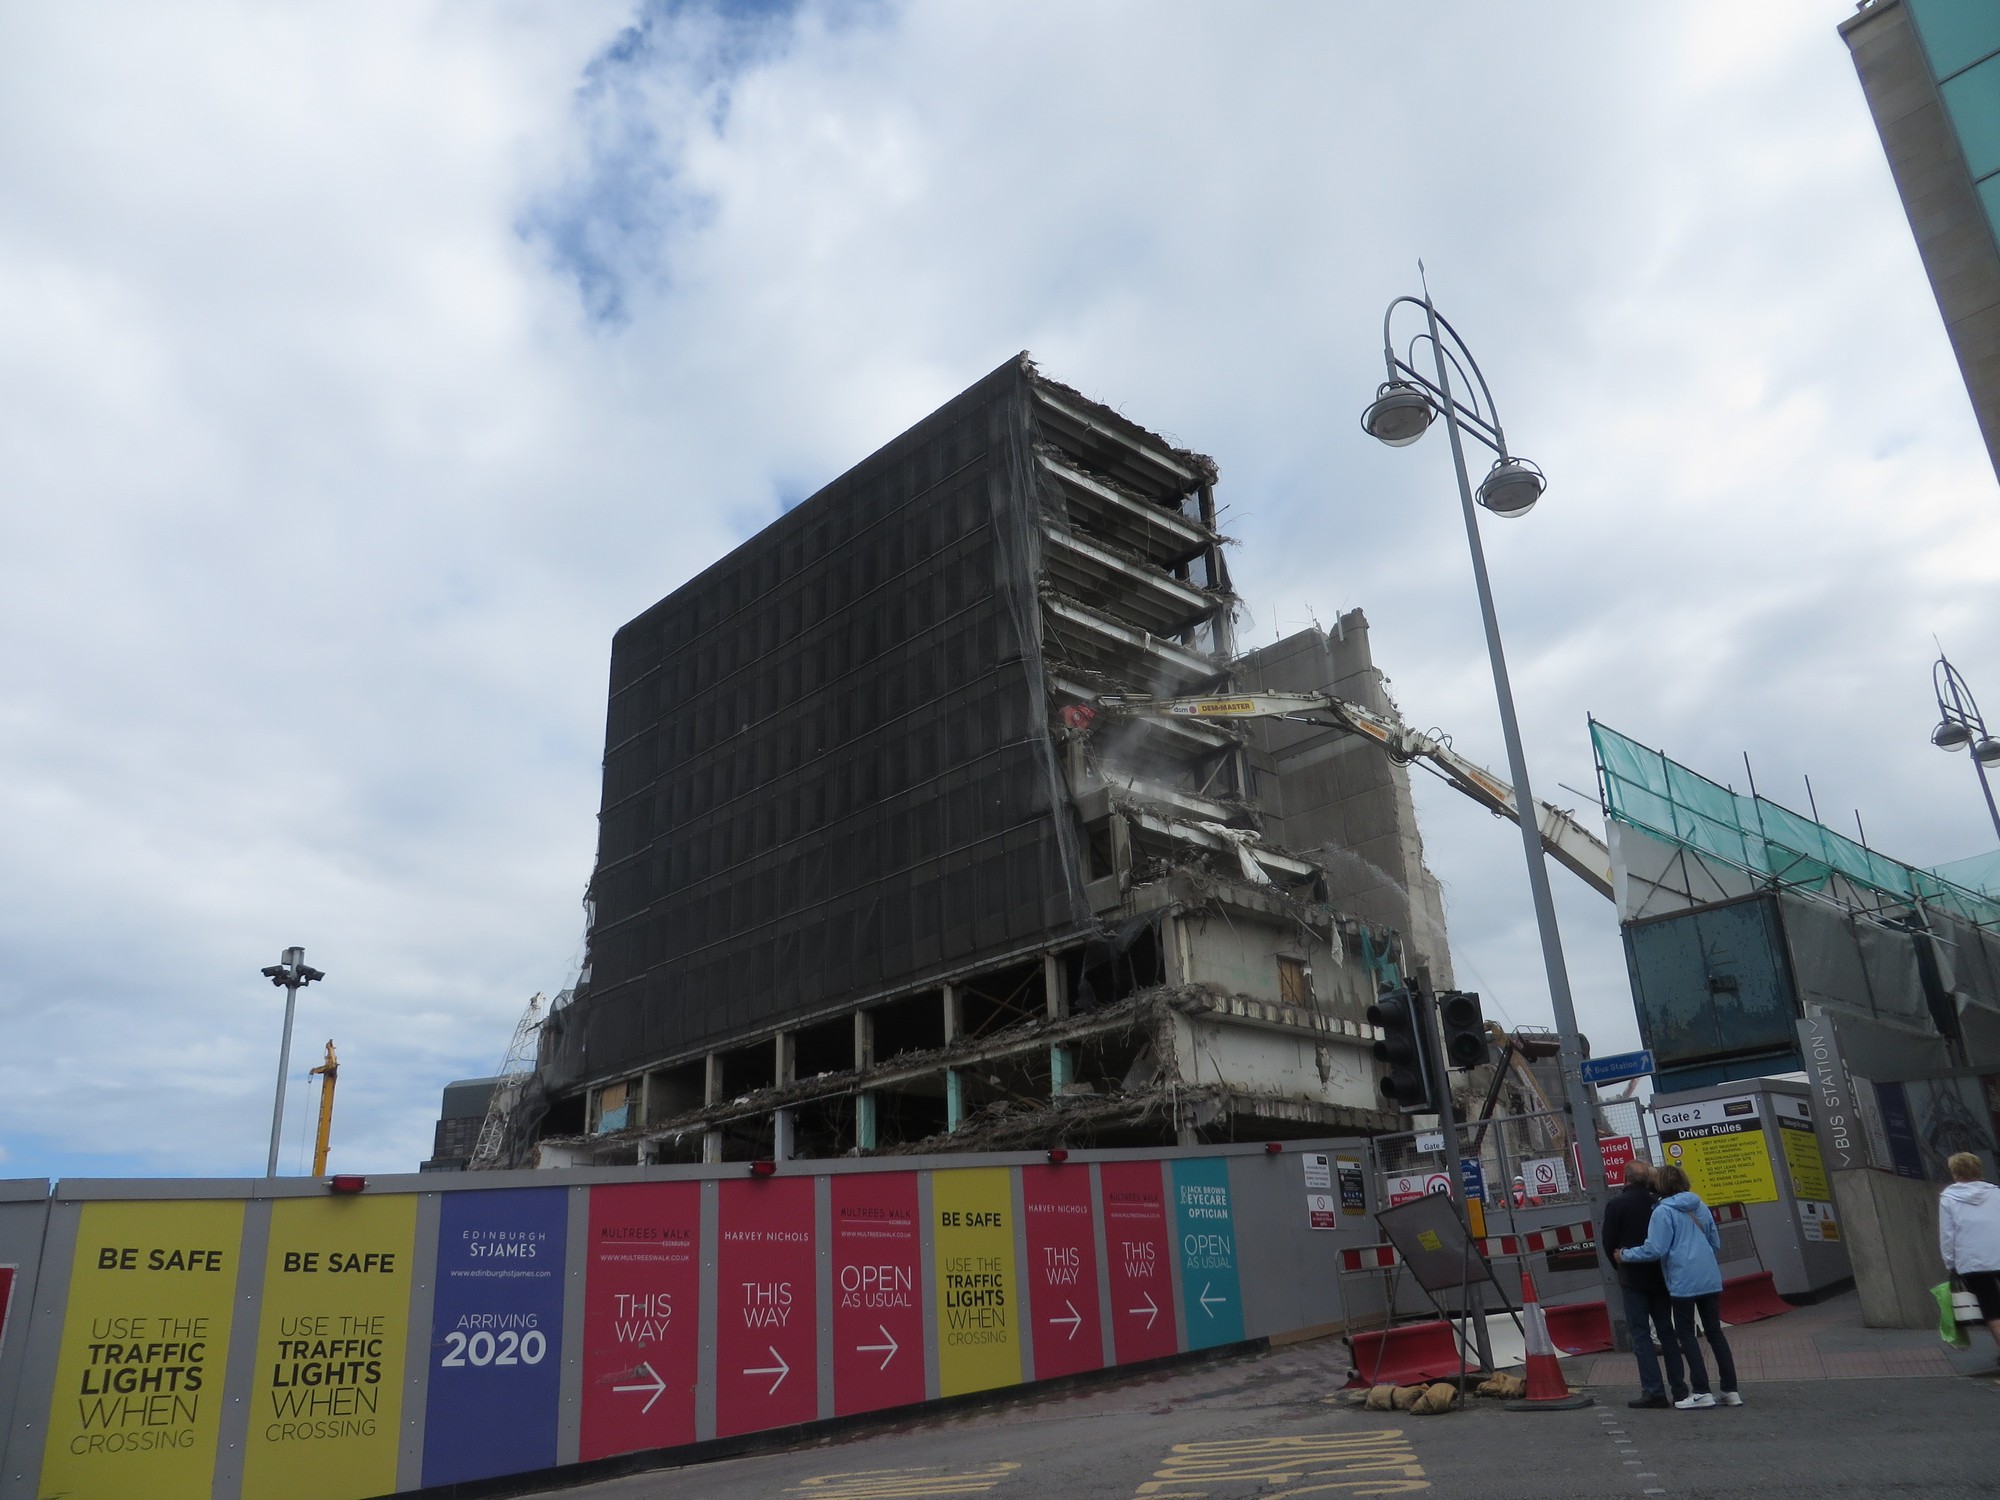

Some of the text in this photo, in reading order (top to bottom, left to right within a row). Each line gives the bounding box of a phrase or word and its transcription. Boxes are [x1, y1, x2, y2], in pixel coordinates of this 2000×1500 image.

[1594, 1060, 1638, 1074] Bus Station
[1812, 1035, 1850, 1150] BUS STATION
[1662, 1109, 1702, 1125] Gate 2
[1678, 1123, 1742, 1139] Driver Rules
[1424, 1143, 1440, 1151] Gate
[1203, 1186, 1226, 1194] BROWN
[1028, 1204, 1088, 1214] HARVEY NICHOLS
[1187, 1194, 1227, 1206] EYECARE
[840, 1208, 911, 1218] MULTREES WALK
[942, 1212, 1002, 1228] BE SAFE
[1188, 1208, 1228, 1219] OPTICIAN
[462, 1230, 546, 1241] EDINBURGH
[600, 1227, 690, 1240] MULTREES WALK
[724, 1231, 810, 1242] HARVEY NICHOLS
[1122, 1242, 1156, 1260] THIS
[1184, 1234, 1231, 1256] OPEN
[98, 1248, 223, 1272] BE SAFE
[283, 1252, 395, 1274] BE SAFE
[600, 1254, 690, 1262] WWW.MULTREESWALK.CO.UK
[946, 1257, 1002, 1273] USE THE
[1044, 1247, 1080, 1266] THIS
[1187, 1256, 1232, 1269] AS USUAL
[450, 1268, 551, 1279] www.edinburghstjames.com
[1046, 1267, 1080, 1285] WAY
[1124, 1260, 1155, 1278] WAY
[840, 1265, 912, 1292] OPEN
[946, 1274, 1003, 1288] TRAFFIC
[742, 1282, 792, 1306] THIS
[841, 1293, 912, 1308] AS USUAL
[946, 1290, 1005, 1308] LIGHTS
[614, 1294, 672, 1318] THIS
[456, 1313, 538, 1330] ARRIVING
[743, 1306, 792, 1328] WAY
[947, 1308, 1006, 1330] WHEN
[91, 1318, 209, 1340] USE THE
[280, 1316, 385, 1338] USE THE
[614, 1319, 671, 1344] WAY
[948, 1330, 1008, 1346] CROSSING
[88, 1342, 206, 1366] TRAFFIC
[277, 1339, 383, 1360] TRAFFIC
[442, 1330, 548, 1368] 2020
[80, 1366, 203, 1396] LIGHTS
[272, 1361, 382, 1388] LIGHTS
[271, 1386, 379, 1420] WHEN
[77, 1395, 198, 1431] WHEN
[265, 1418, 377, 1444] CROSSING
[70, 1429, 195, 1456] CROSSING
